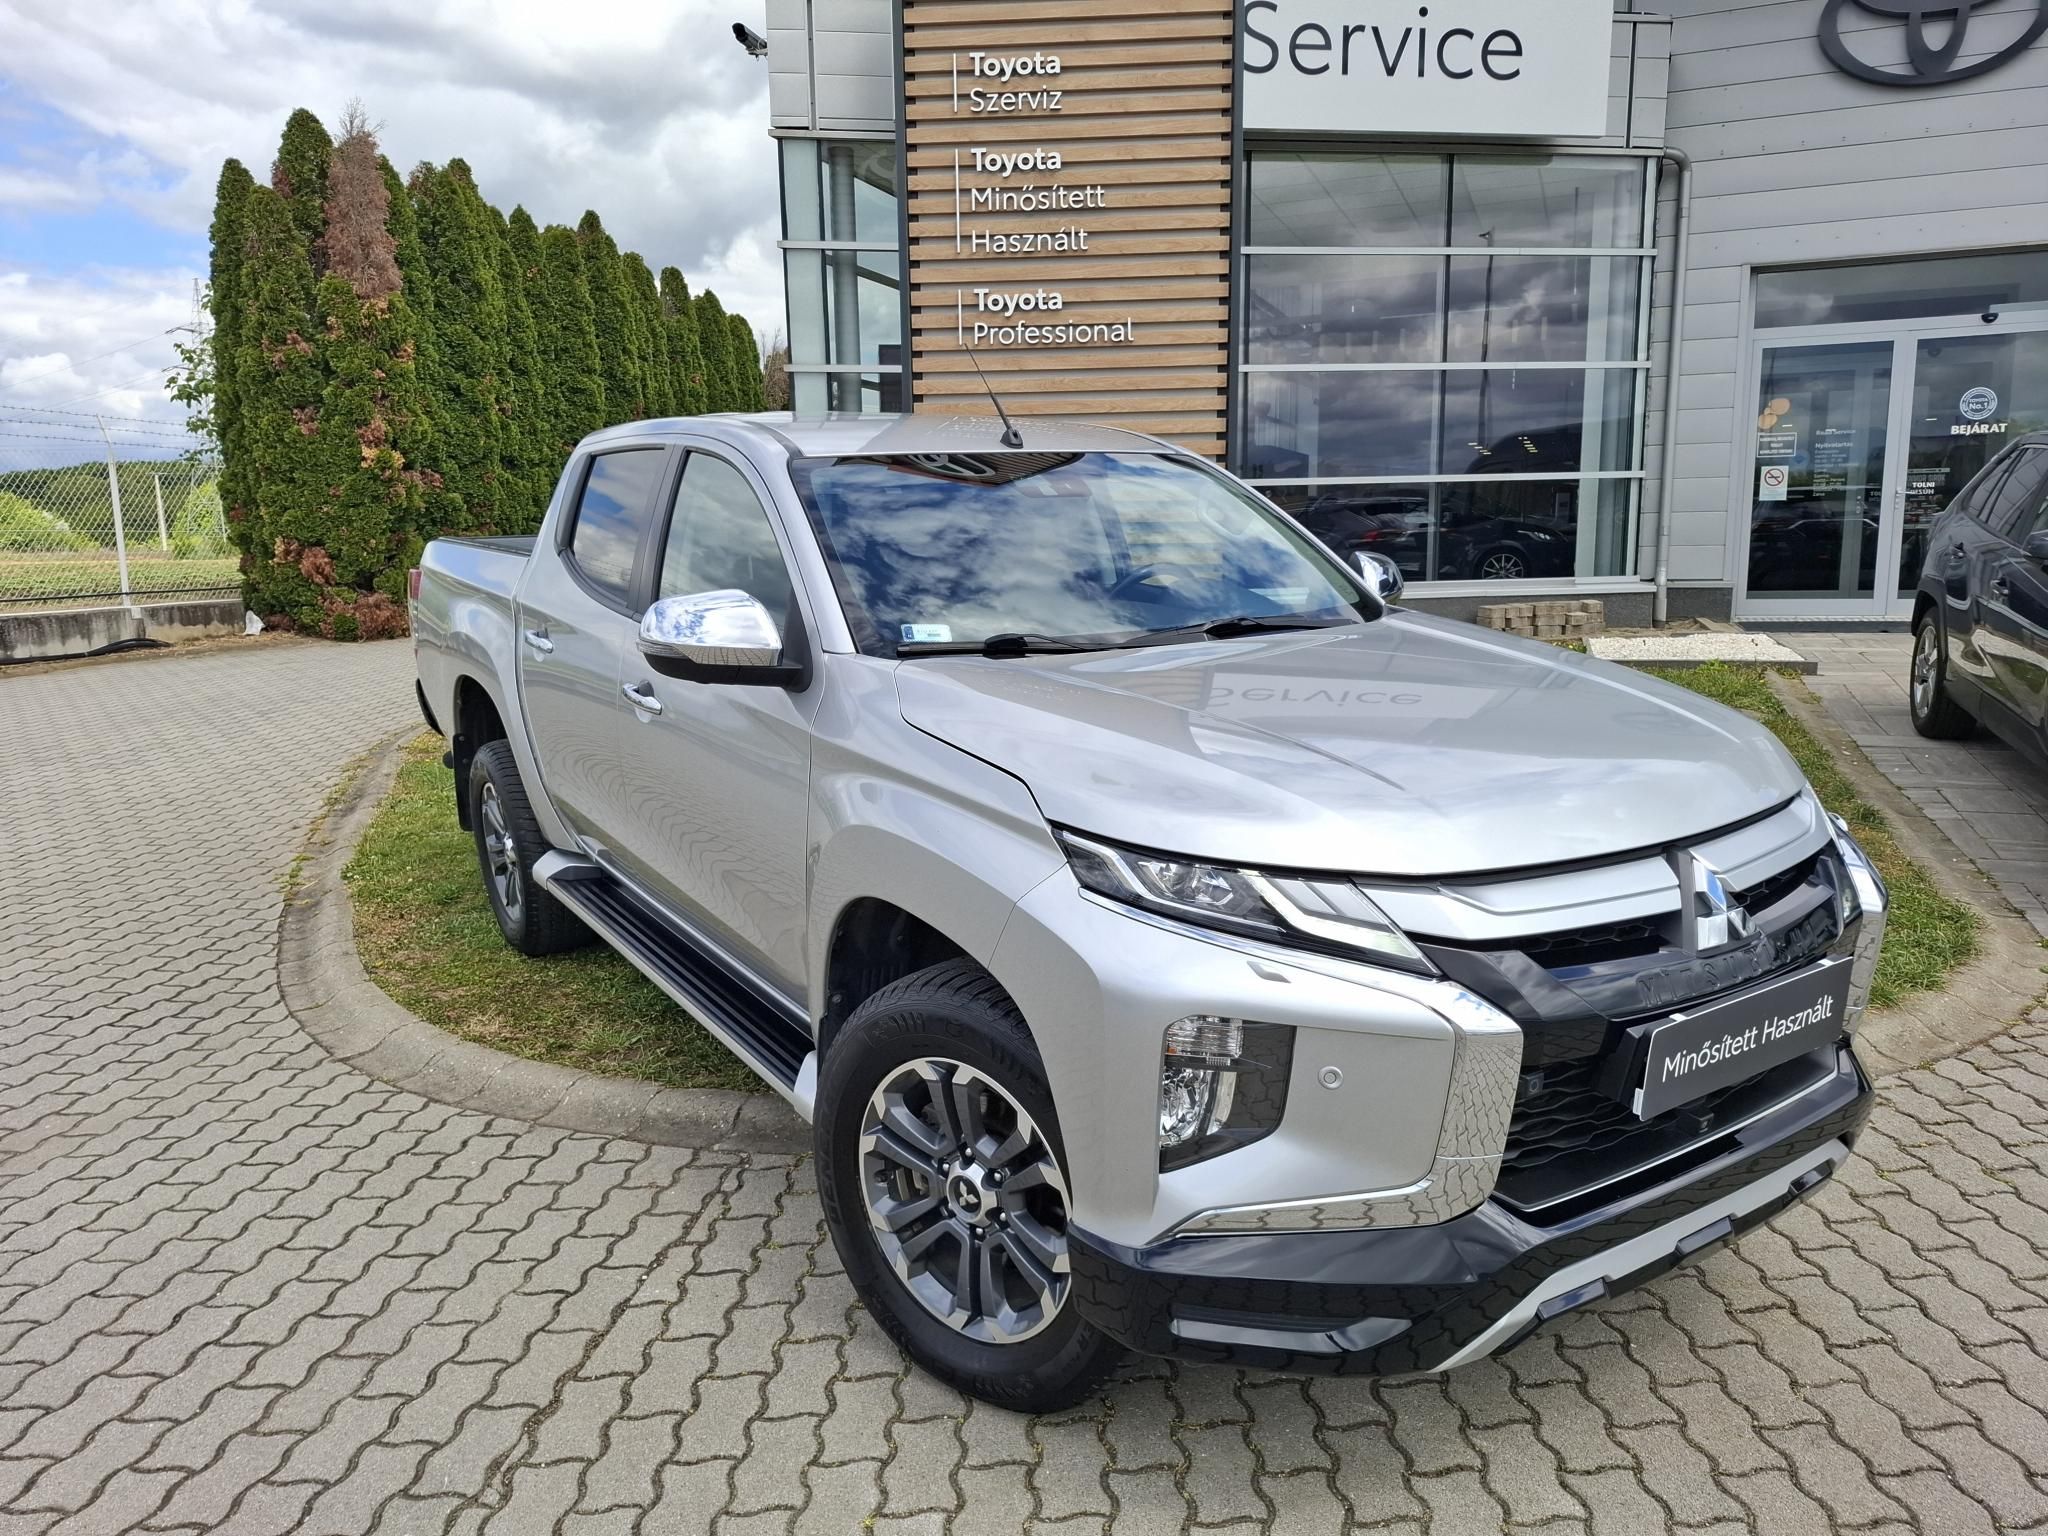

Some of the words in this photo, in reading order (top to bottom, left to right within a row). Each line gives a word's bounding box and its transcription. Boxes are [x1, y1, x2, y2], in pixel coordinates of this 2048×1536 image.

[1243, 0, 1523, 81] Service
[969, 51, 1062, 82] Toyota
[969, 86, 1063, 113] Szerviz
[971, 147, 1062, 177] Toyota
[971, 185, 1106, 212] Minősített
[971, 227, 1089, 254] Használt
[973, 288, 1063, 317] Toyota
[973, 318, 1135, 346] Professional
[1951, 422, 2008, 436] BEJÁRAT
[1662, 1027, 1757, 1082] Minősített
[1762, 995, 1834, 1044] Használt
